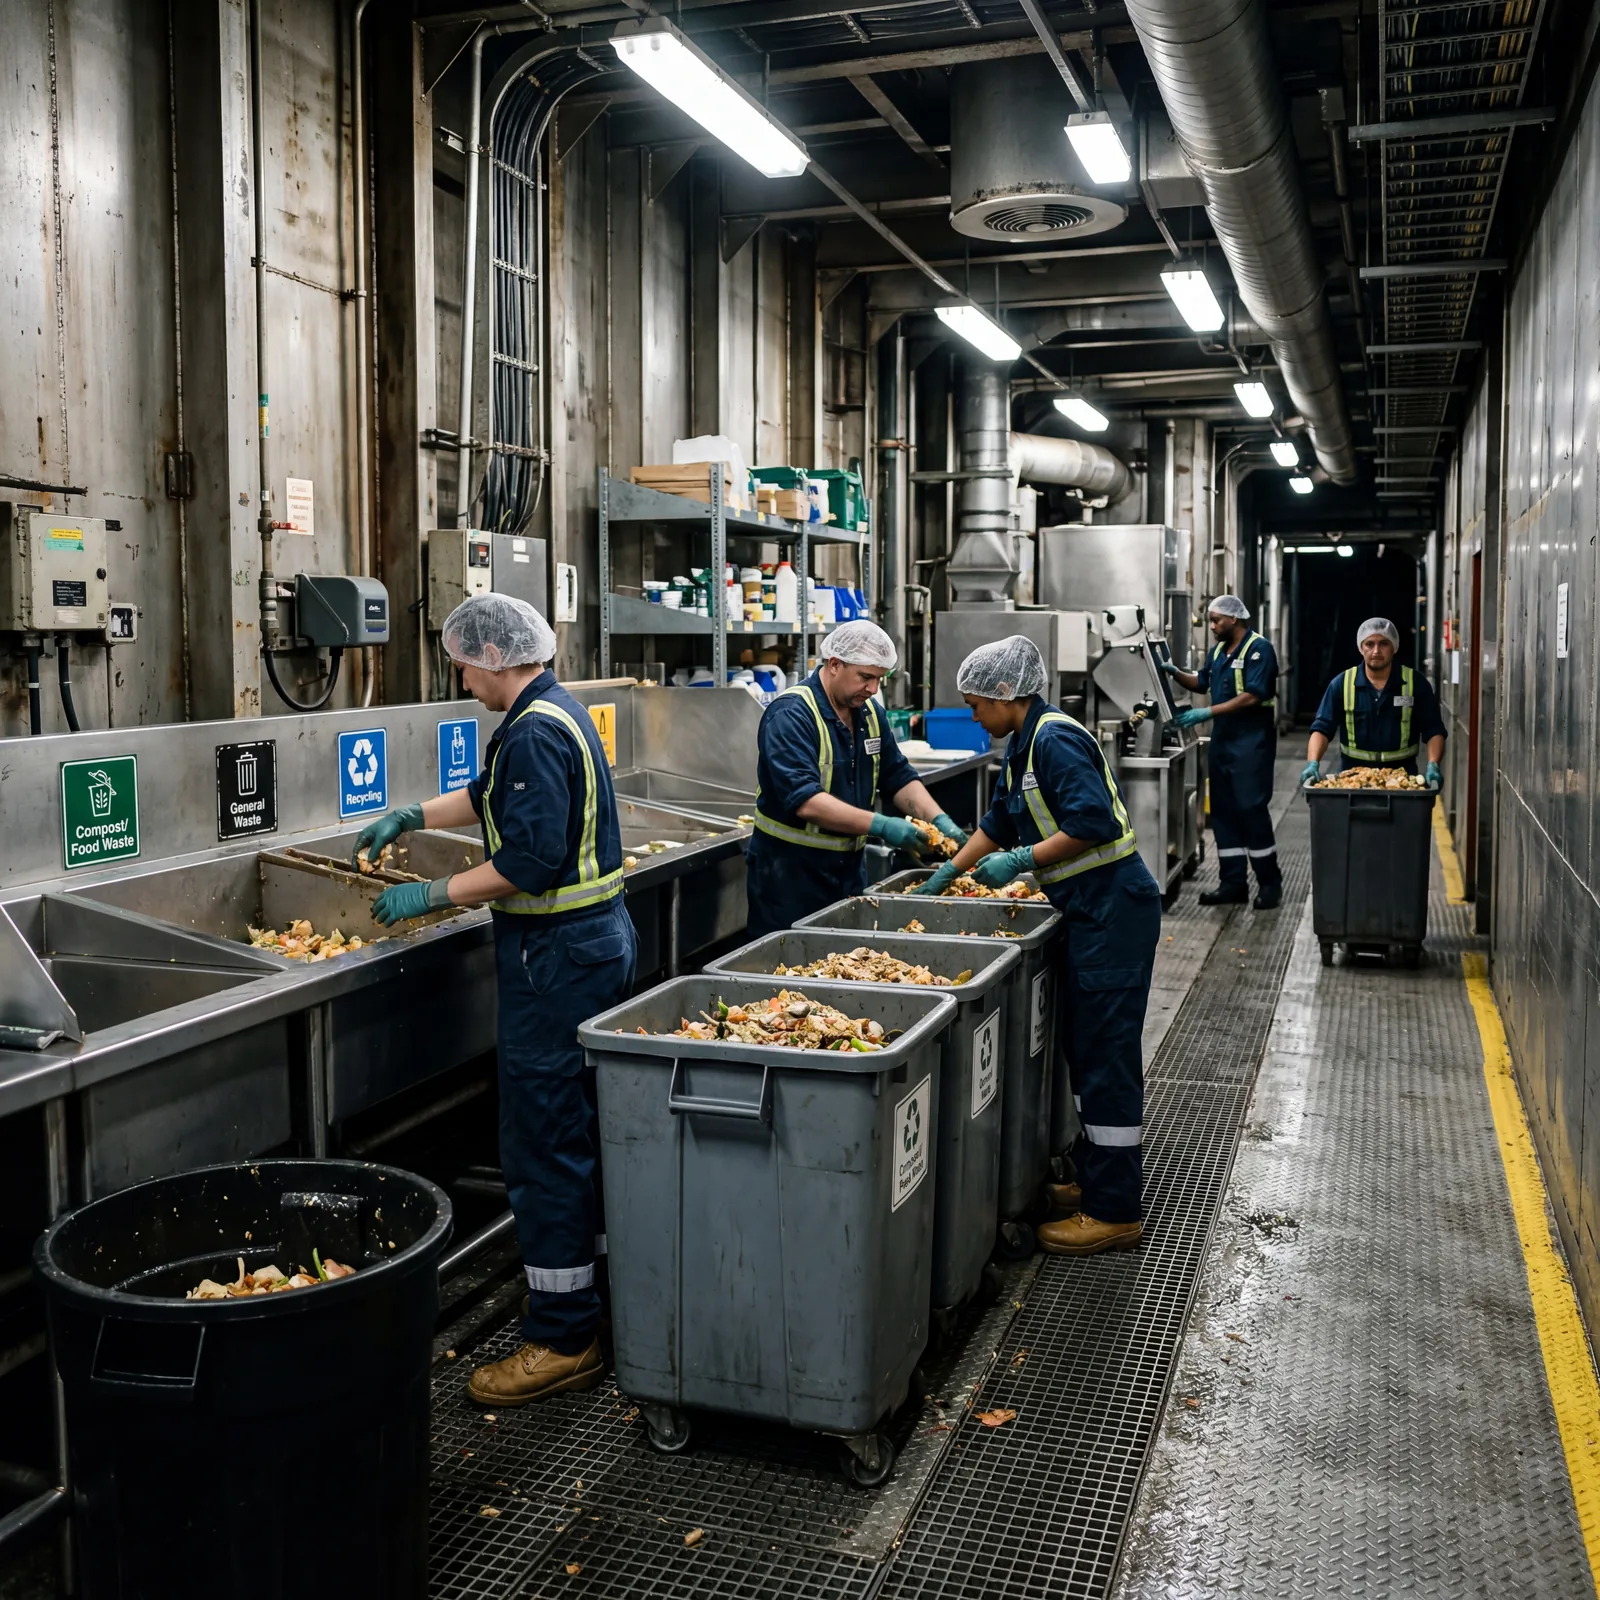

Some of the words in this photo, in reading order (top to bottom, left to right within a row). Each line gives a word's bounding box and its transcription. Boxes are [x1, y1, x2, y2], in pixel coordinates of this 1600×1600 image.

[230, 797, 265, 815] General
[346, 790, 382, 806] Recycling
[75, 817, 129, 839] Compost/
[233, 813, 262, 828] Waste
[71, 839, 100, 856] Food
[102, 834, 134, 851] Waste
